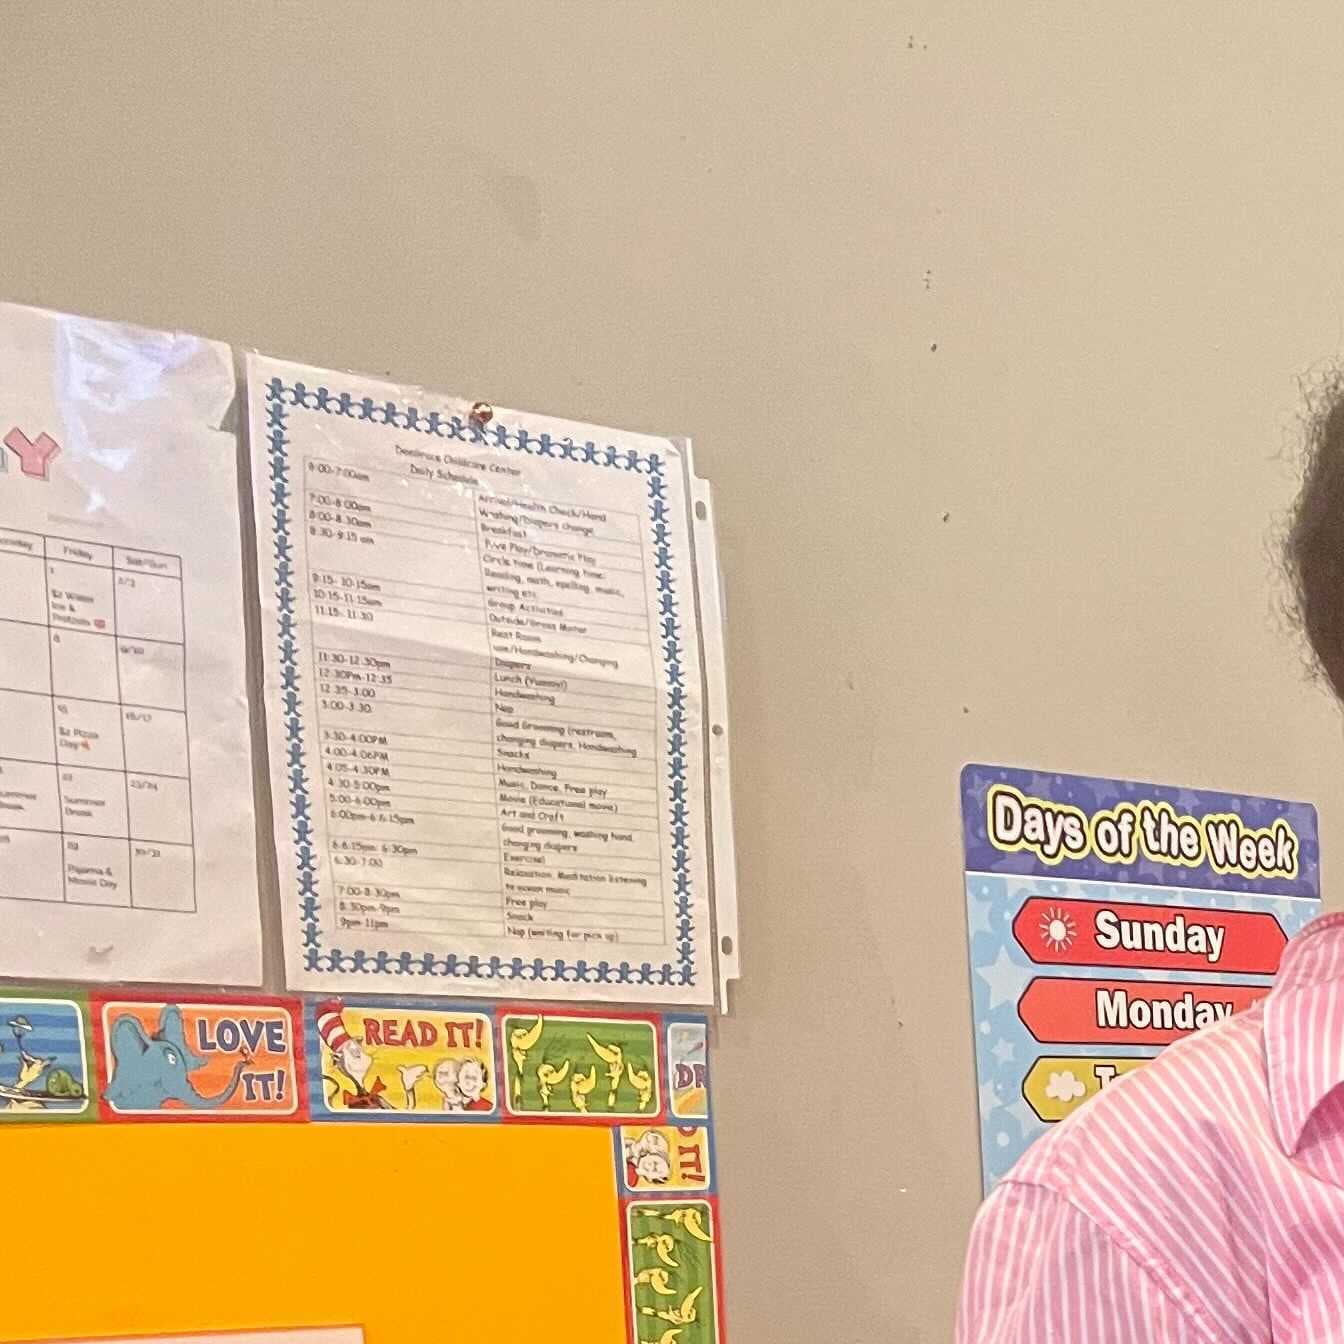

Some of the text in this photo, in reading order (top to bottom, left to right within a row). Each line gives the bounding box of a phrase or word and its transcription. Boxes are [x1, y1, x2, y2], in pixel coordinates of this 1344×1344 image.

[992, 790, 1295, 874] Days of the Week
[1094, 908, 1226, 963] Sunday
[198, 1018, 286, 1052] LOVE
[363, 1018, 484, 1049] READ IT!
[241, 1069, 285, 1101] IT!
